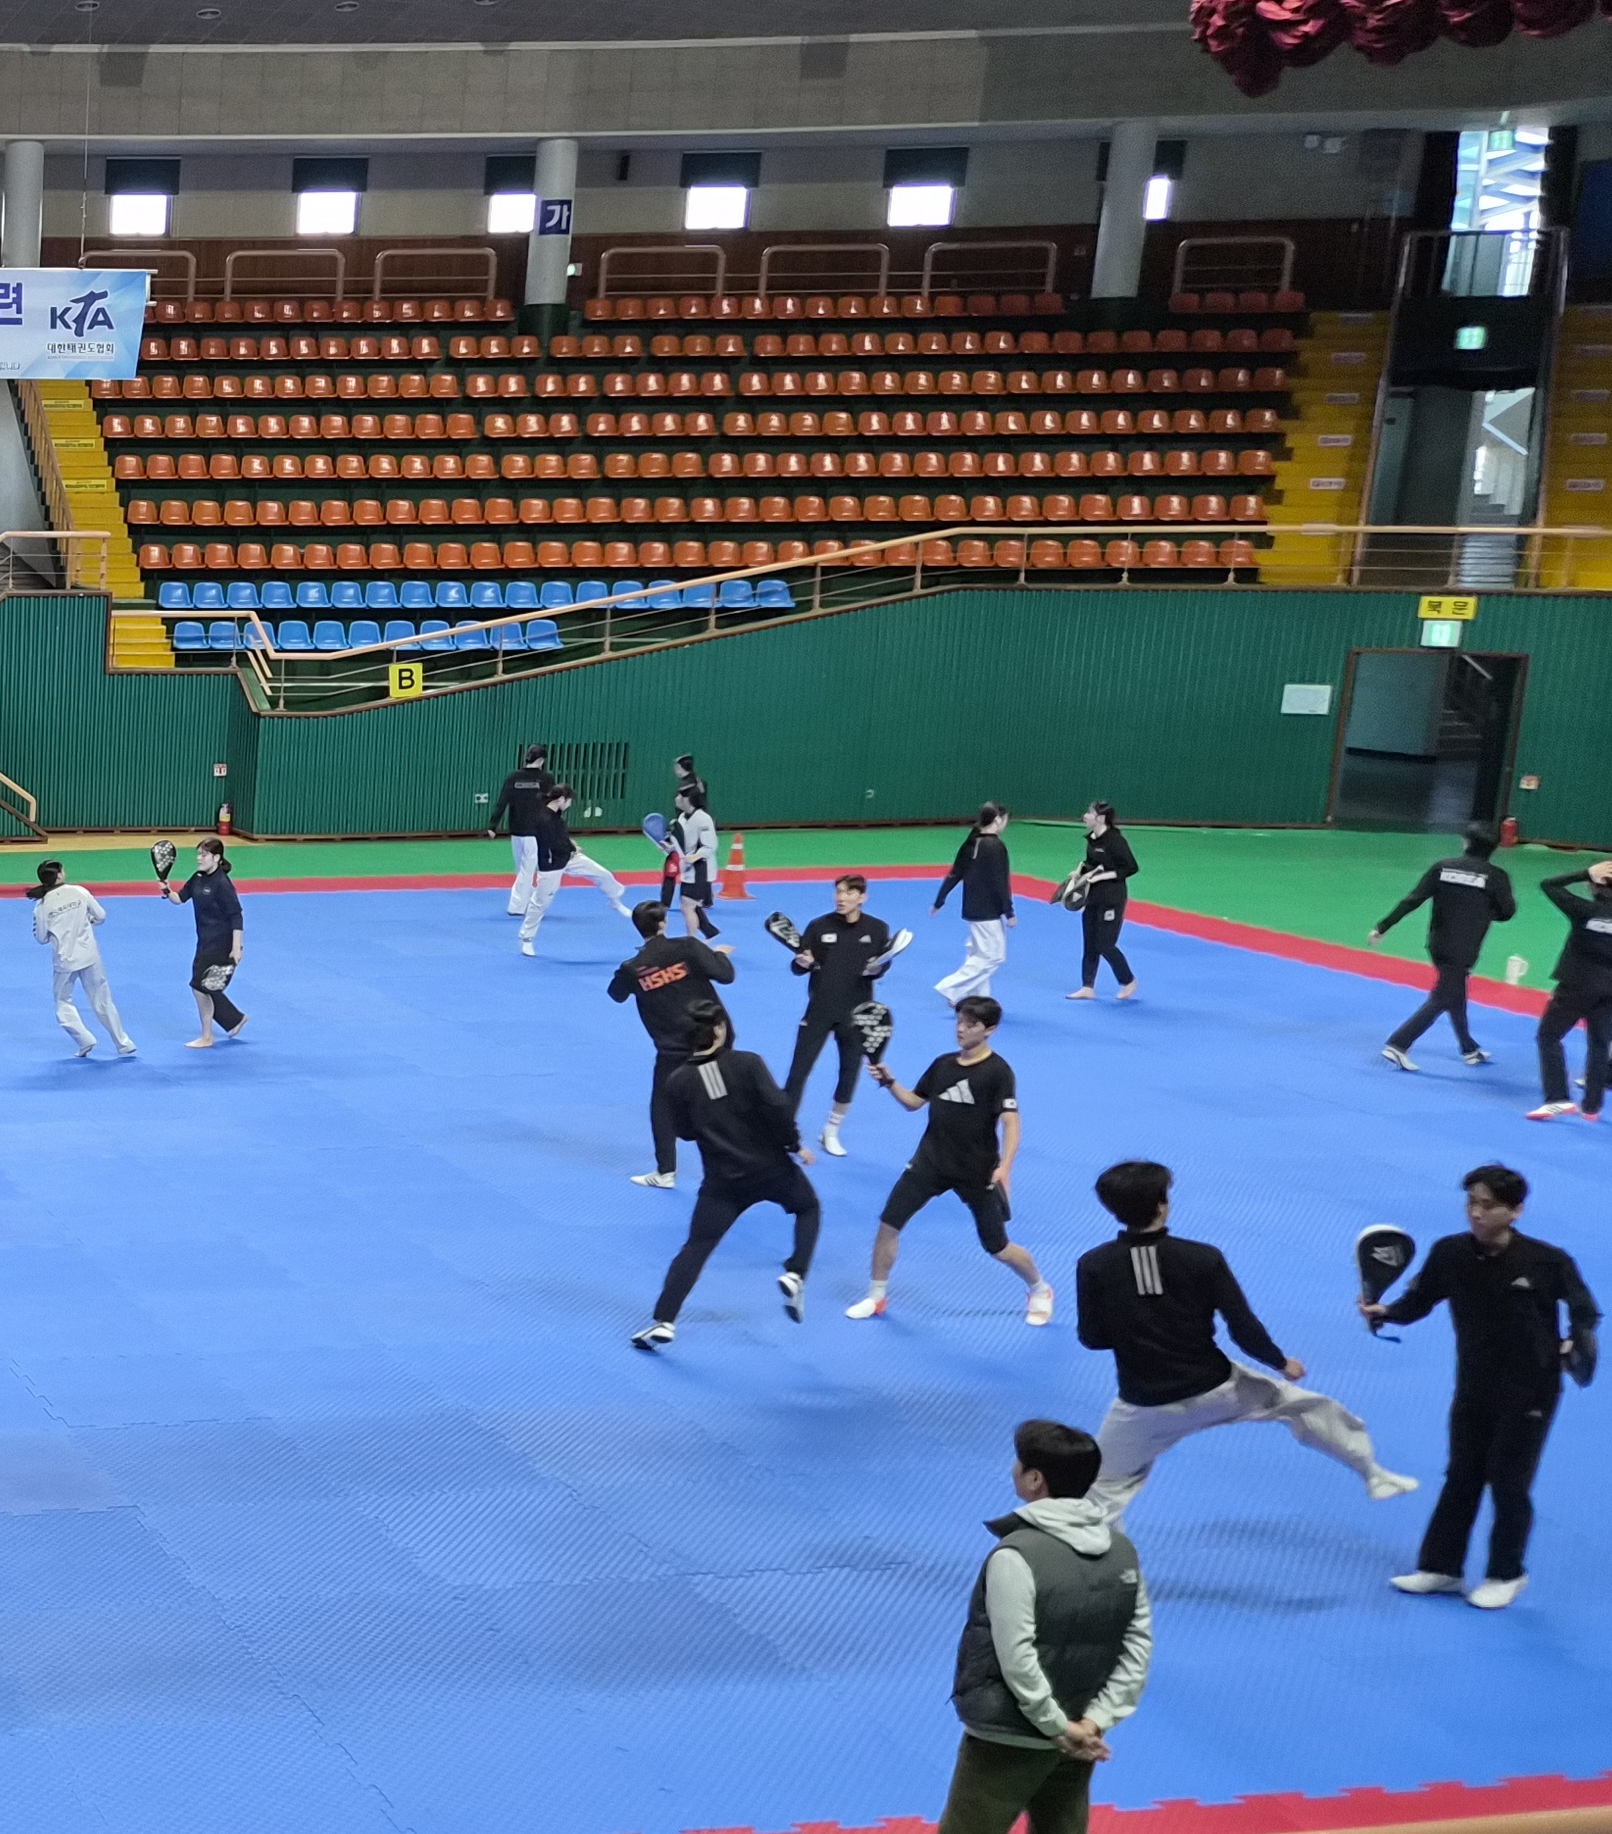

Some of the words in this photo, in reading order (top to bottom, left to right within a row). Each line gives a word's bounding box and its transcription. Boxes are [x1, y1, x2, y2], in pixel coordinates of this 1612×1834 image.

[545, 204, 570, 230] 가
[49, 290, 115, 338] KTA
[47, 343, 115, 355] 대한태권도협회
[398, 668, 415, 690] B
